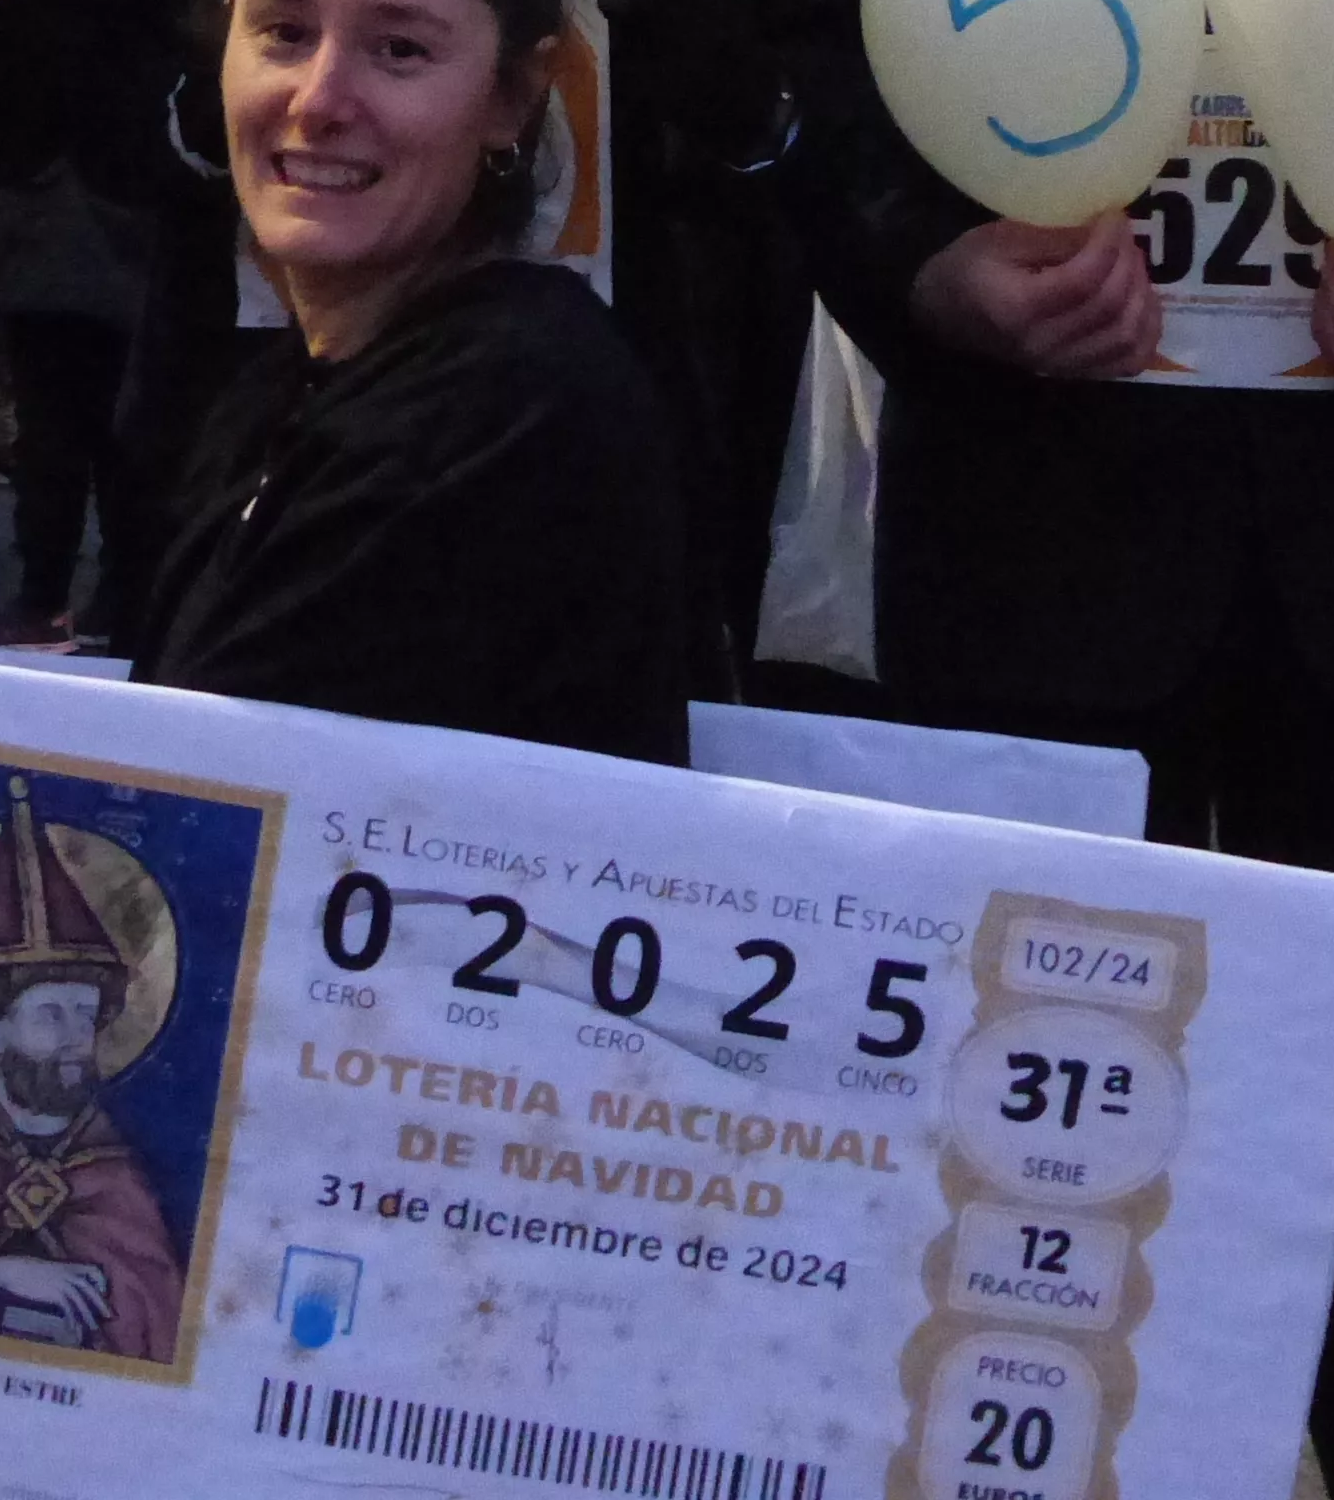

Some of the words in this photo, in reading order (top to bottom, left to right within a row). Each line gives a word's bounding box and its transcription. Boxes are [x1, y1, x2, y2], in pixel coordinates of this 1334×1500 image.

[322, 871, 392, 972] 0
[452, 895, 527, 998] 2
[591, 916, 662, 1018] 0
[721, 939, 797, 1041] 2
[856, 959, 928, 1059] 5
[1023, 939, 1151, 988] 102/24
[307, 978, 377, 1011] CERO
[446, 1001, 500, 1032] DOS
[577, 1023, 646, 1057] CERO
[714, 1045, 769, 1076] DOS
[837, 1064, 919, 1098] CINCO
[588, 1089, 901, 1175] NACIONAL
[397, 1122, 476, 1169] DE
[501, 1142, 785, 1218] NAVIDAD
[1022, 1155, 1087, 1187] SERIE
[317, 1174, 366, 1212] 31
[377, 1185, 430, 1223] de
[442, 1197, 662, 1262] diciembre
[676, 1234, 730, 1272] de
[742, 1246, 849, 1293] 2024
[1020, 1225, 1072, 1275] 12
[967, 1270, 1100, 1310] FRACCIÓN
[977, 1355, 1066, 1389] PRECIO
[964, 1400, 1055, 1471] 20
